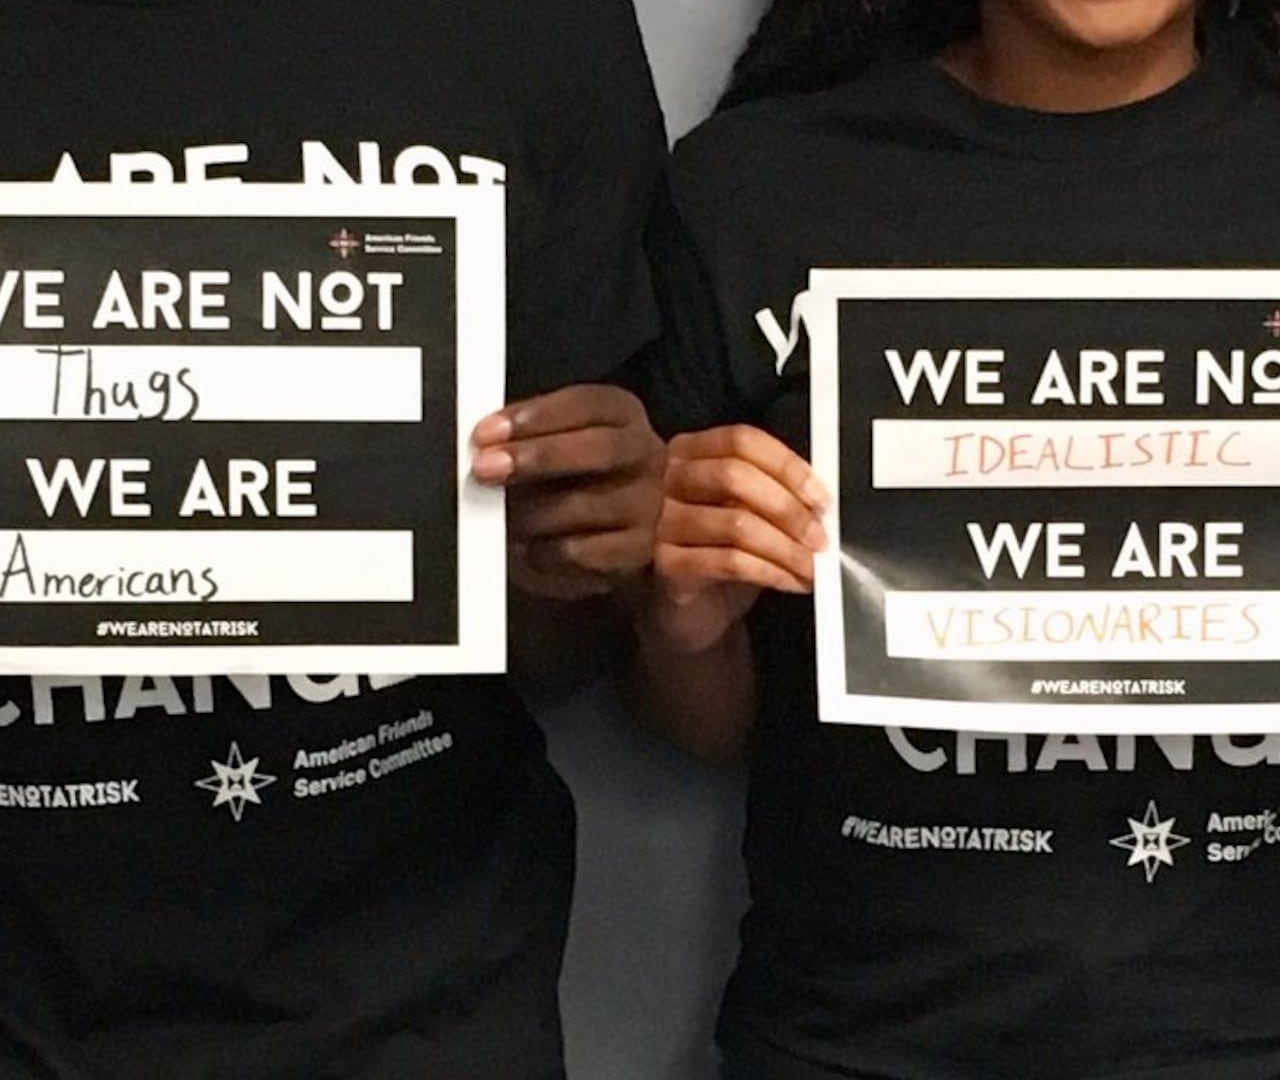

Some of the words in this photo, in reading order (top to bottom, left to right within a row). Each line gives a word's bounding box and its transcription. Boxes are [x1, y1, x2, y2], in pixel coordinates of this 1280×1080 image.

[93, 270, 229, 329] ARE
[263, 271, 402, 330] NOT
[36, 347, 200, 420] Thugs
[885, 350, 1004, 404] WE
[1032, 350, 1164, 404] ARE
[946, 431, 1250, 476] IDEALISTIC
[26, 459, 150, 516] WE
[180, 459, 316, 516] ARE
[967, 523, 1085, 579] WE
[1112, 522, 1243, 577] ARE
[97, 621, 258, 636] #WEARENOTATRISK
[927, 604, 1261, 648] VISIONARIES
[1030, 680, 1185, 695] #WEARENOTATRISK
[293, 734, 376, 770] American
[293, 768, 367, 798] Service
[368, 732, 453, 779] Committee
